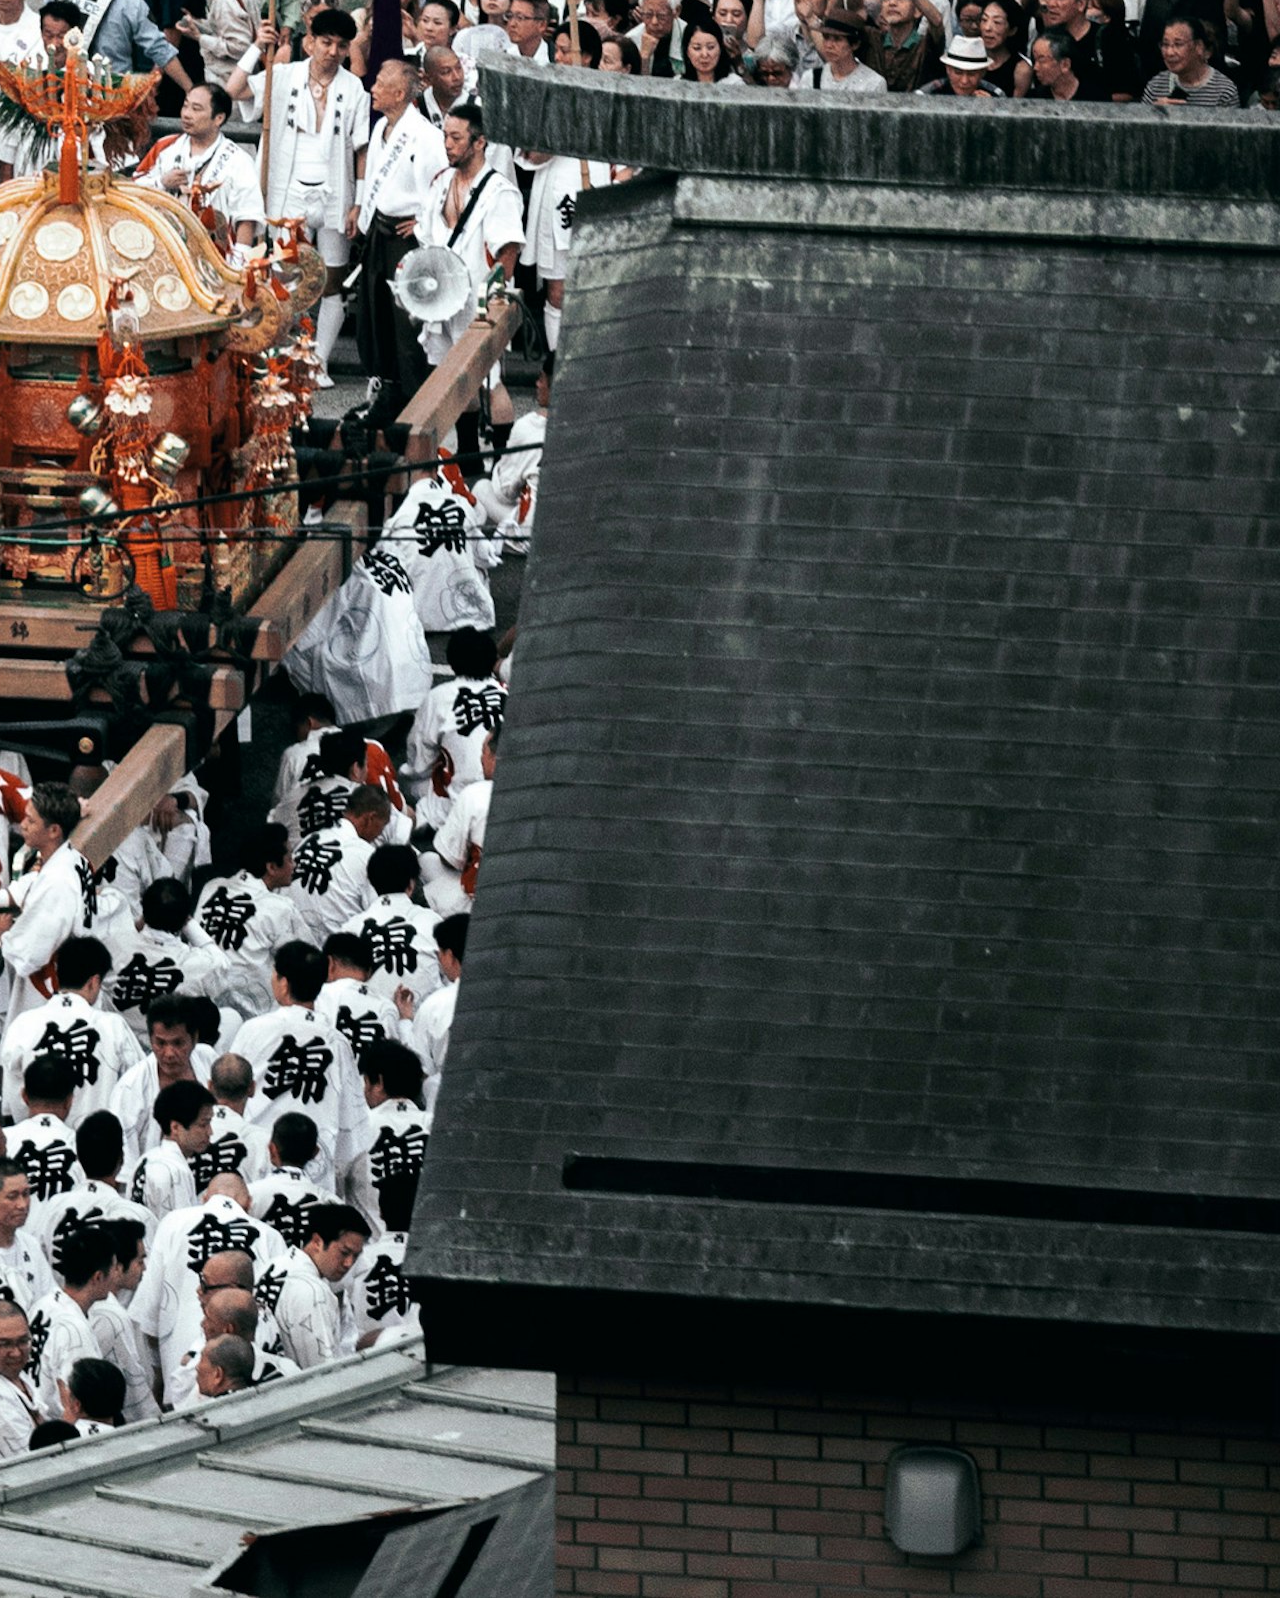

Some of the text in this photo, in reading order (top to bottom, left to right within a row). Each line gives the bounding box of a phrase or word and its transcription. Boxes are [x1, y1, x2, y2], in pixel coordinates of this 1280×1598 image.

[413, 498, 466, 556] 錦
[453, 685, 507, 734] 錦
[294, 834, 342, 894] 錦
[200, 887, 255, 950] 錦
[364, 916, 417, 974] 錦
[113, 953, 184, 1013] 錦
[263, 1036, 334, 1104] 錦
[16, 1139, 76, 1200] 錦
